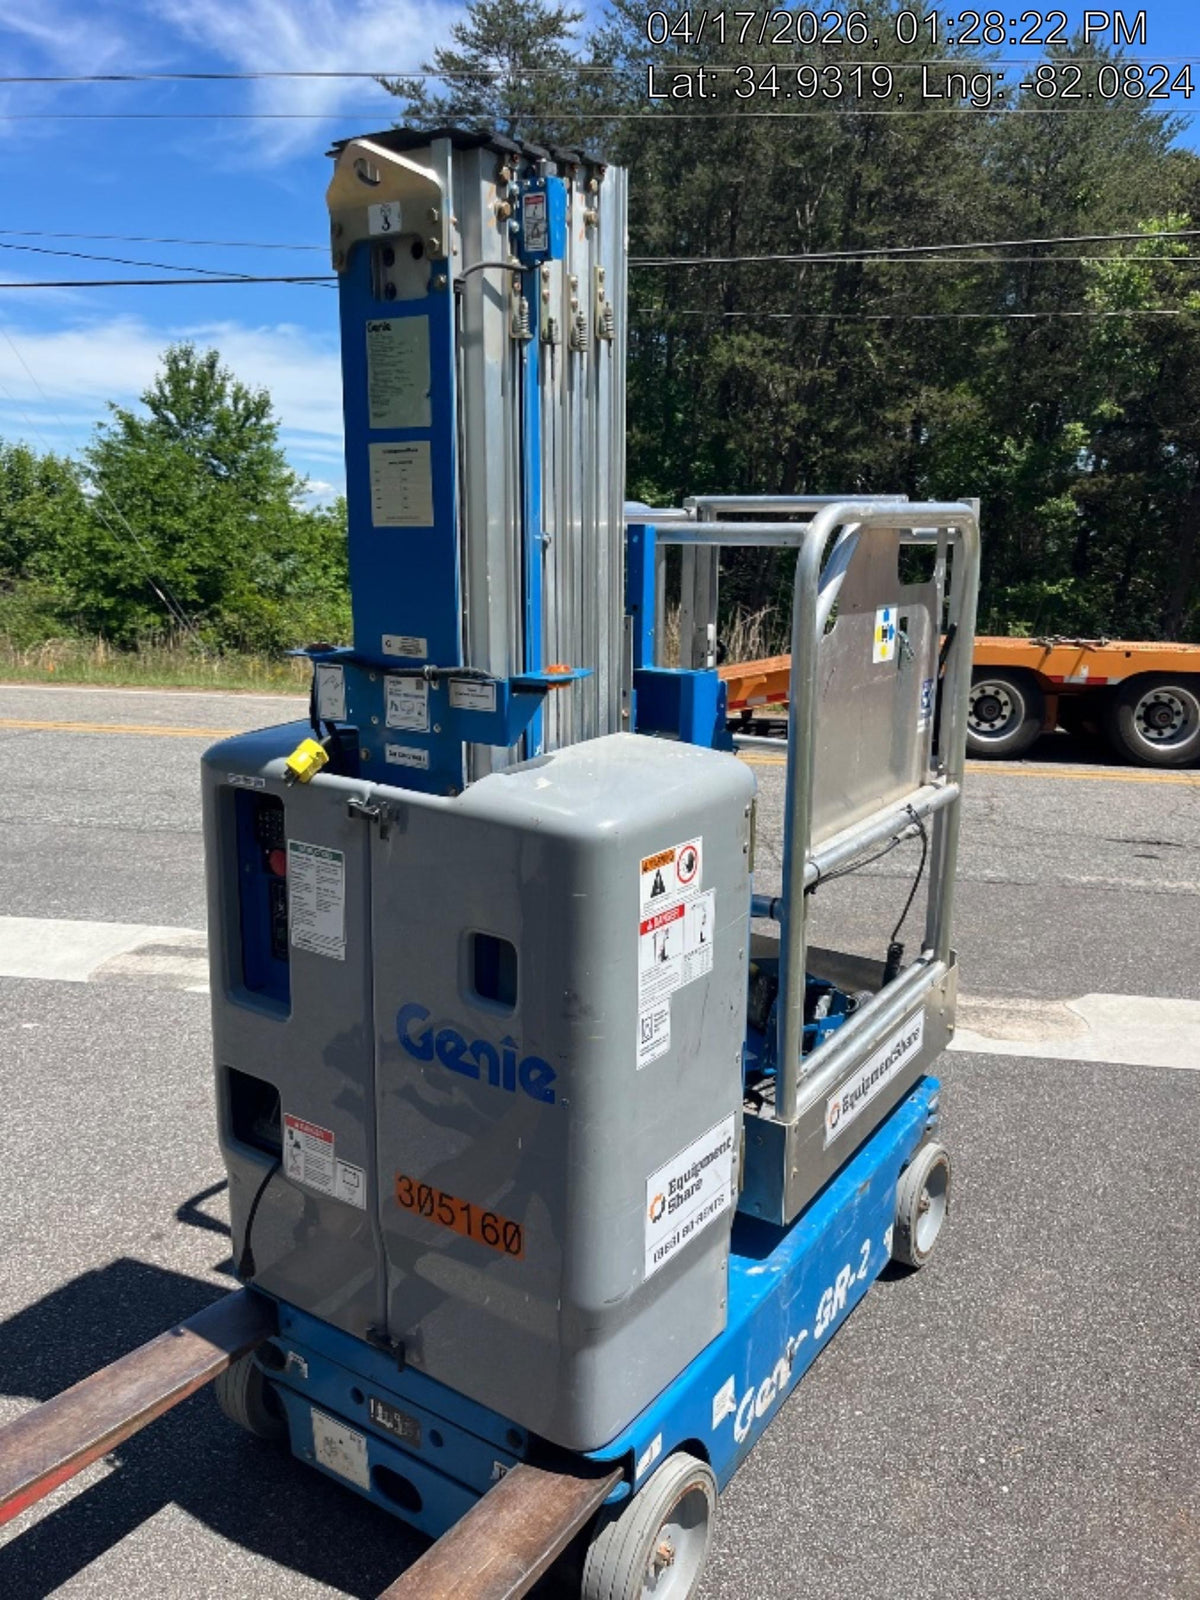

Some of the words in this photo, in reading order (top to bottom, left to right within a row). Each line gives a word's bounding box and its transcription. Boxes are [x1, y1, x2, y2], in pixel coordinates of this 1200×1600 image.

[396, 1002, 557, 1105] Genie
[667, 1136, 732, 1198] Equipment
[667, 1178, 703, 1216] Share
[397, 1174, 522, 1255] 305160
